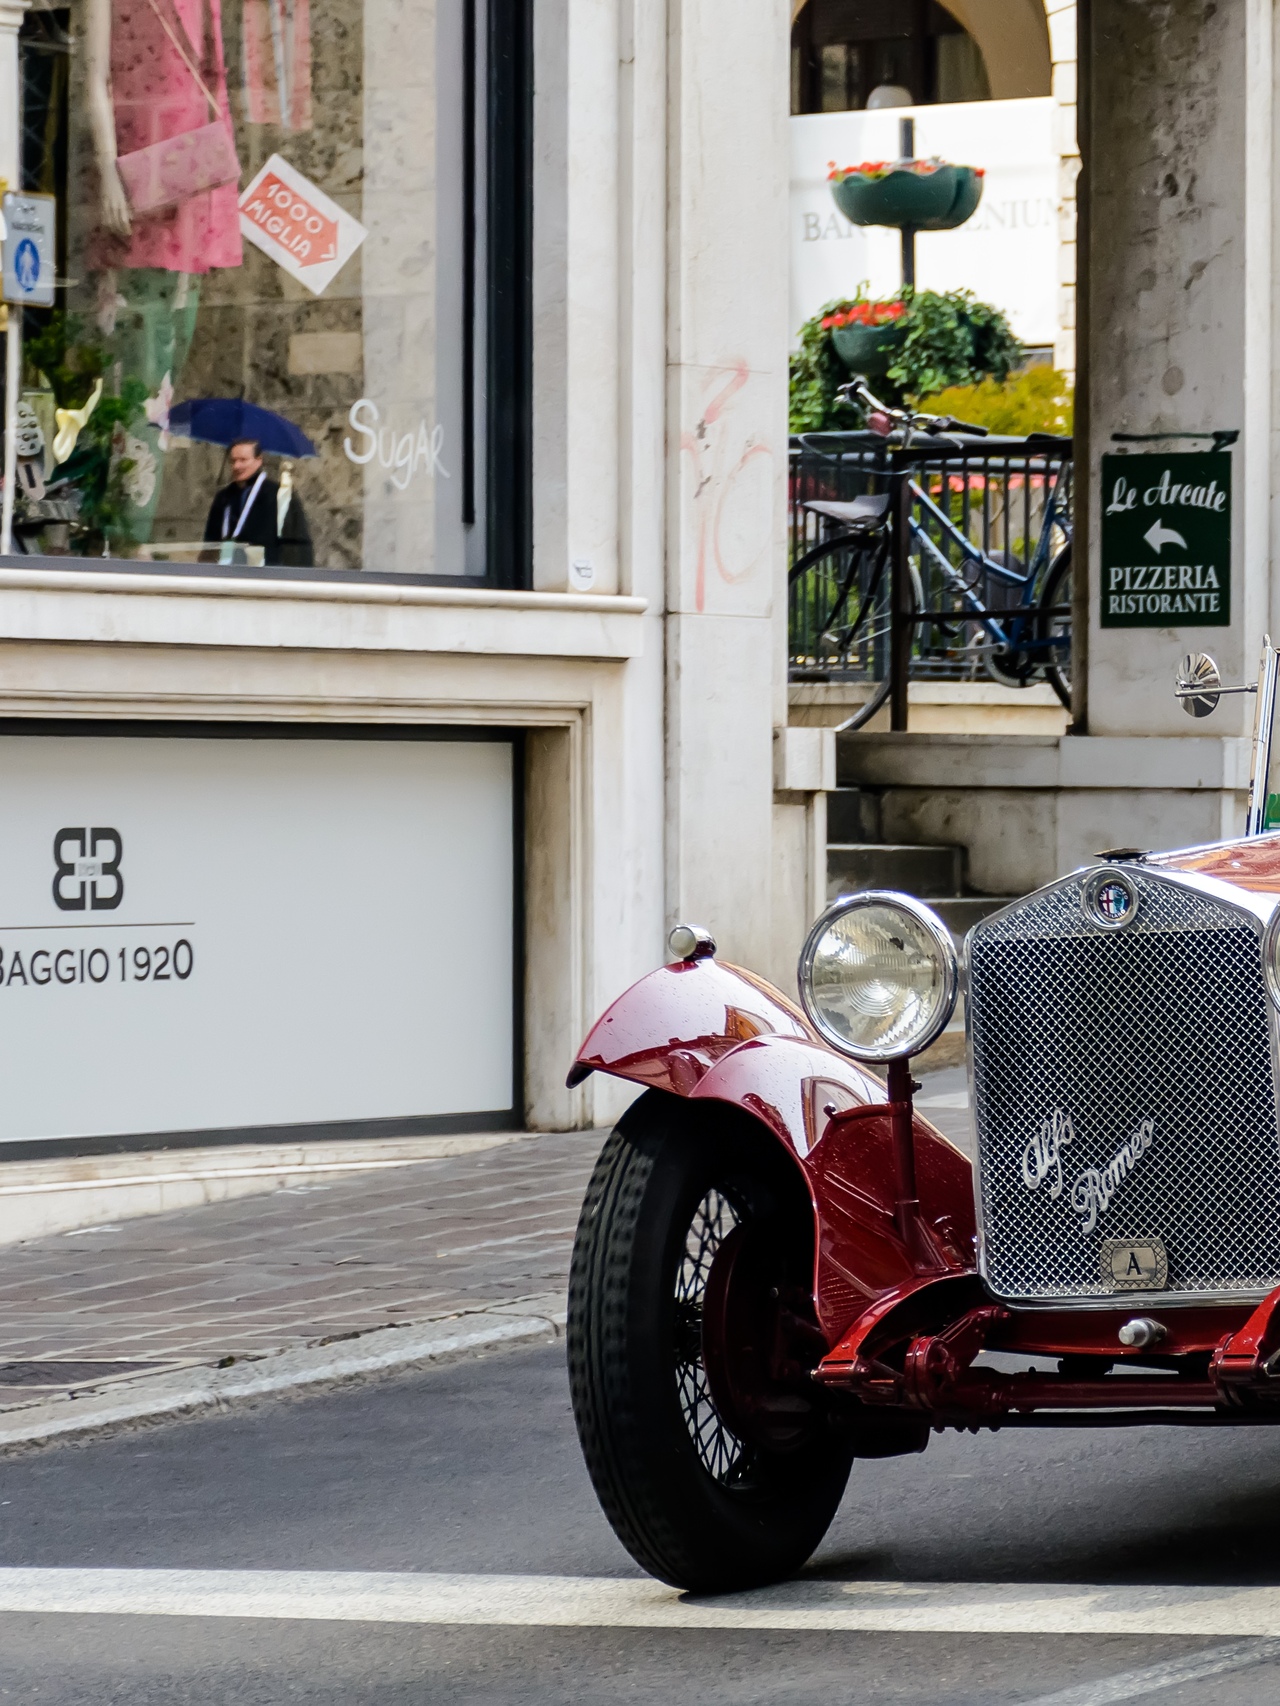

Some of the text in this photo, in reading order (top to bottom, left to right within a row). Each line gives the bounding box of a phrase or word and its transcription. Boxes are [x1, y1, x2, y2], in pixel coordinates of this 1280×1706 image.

[245, 199, 312, 258] MIGLIA
[267, 183, 323, 234] 1000
[1105, 476, 1138, 516] Le
[1108, 565, 1221, 591] PIZZERIA
[1108, 593, 1221, 614] RISTORANTE
[0, 939, 194, 986] AGGIO 1920
[1022, 1107, 1076, 1200] Alfa
[1071, 1119, 1155, 1236] Romeo
[1126, 1252, 1142, 1276] A
